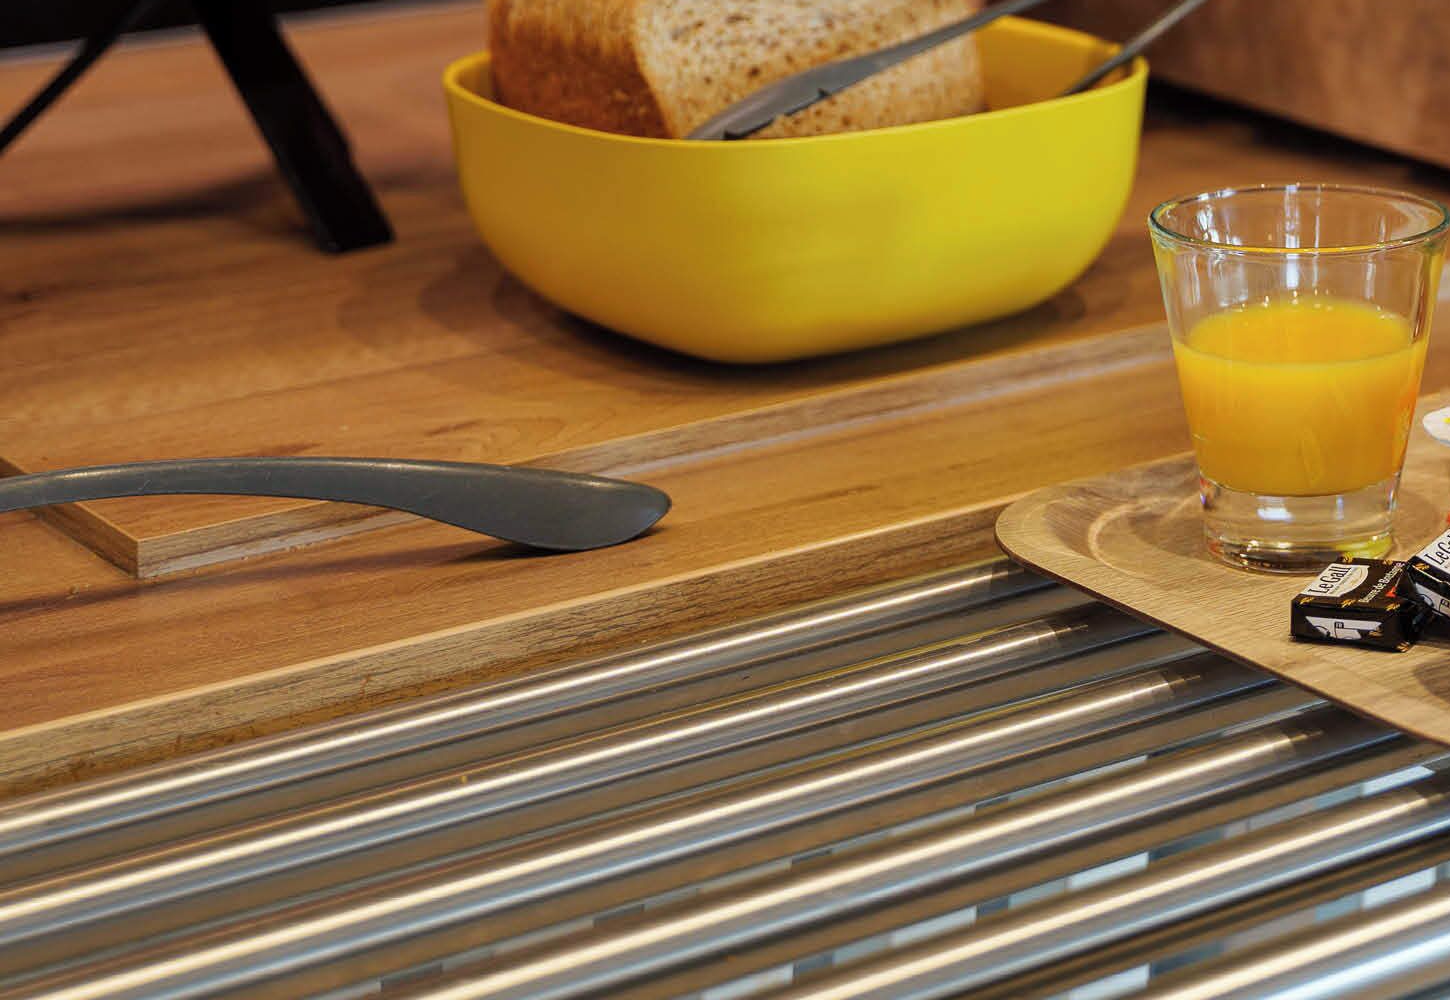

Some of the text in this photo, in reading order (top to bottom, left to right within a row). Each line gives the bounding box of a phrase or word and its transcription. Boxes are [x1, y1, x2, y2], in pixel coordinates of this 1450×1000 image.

[1424, 551, 1449, 566] Le
[1320, 566, 1351, 587] Gall
[1308, 581, 1334, 594] Le
